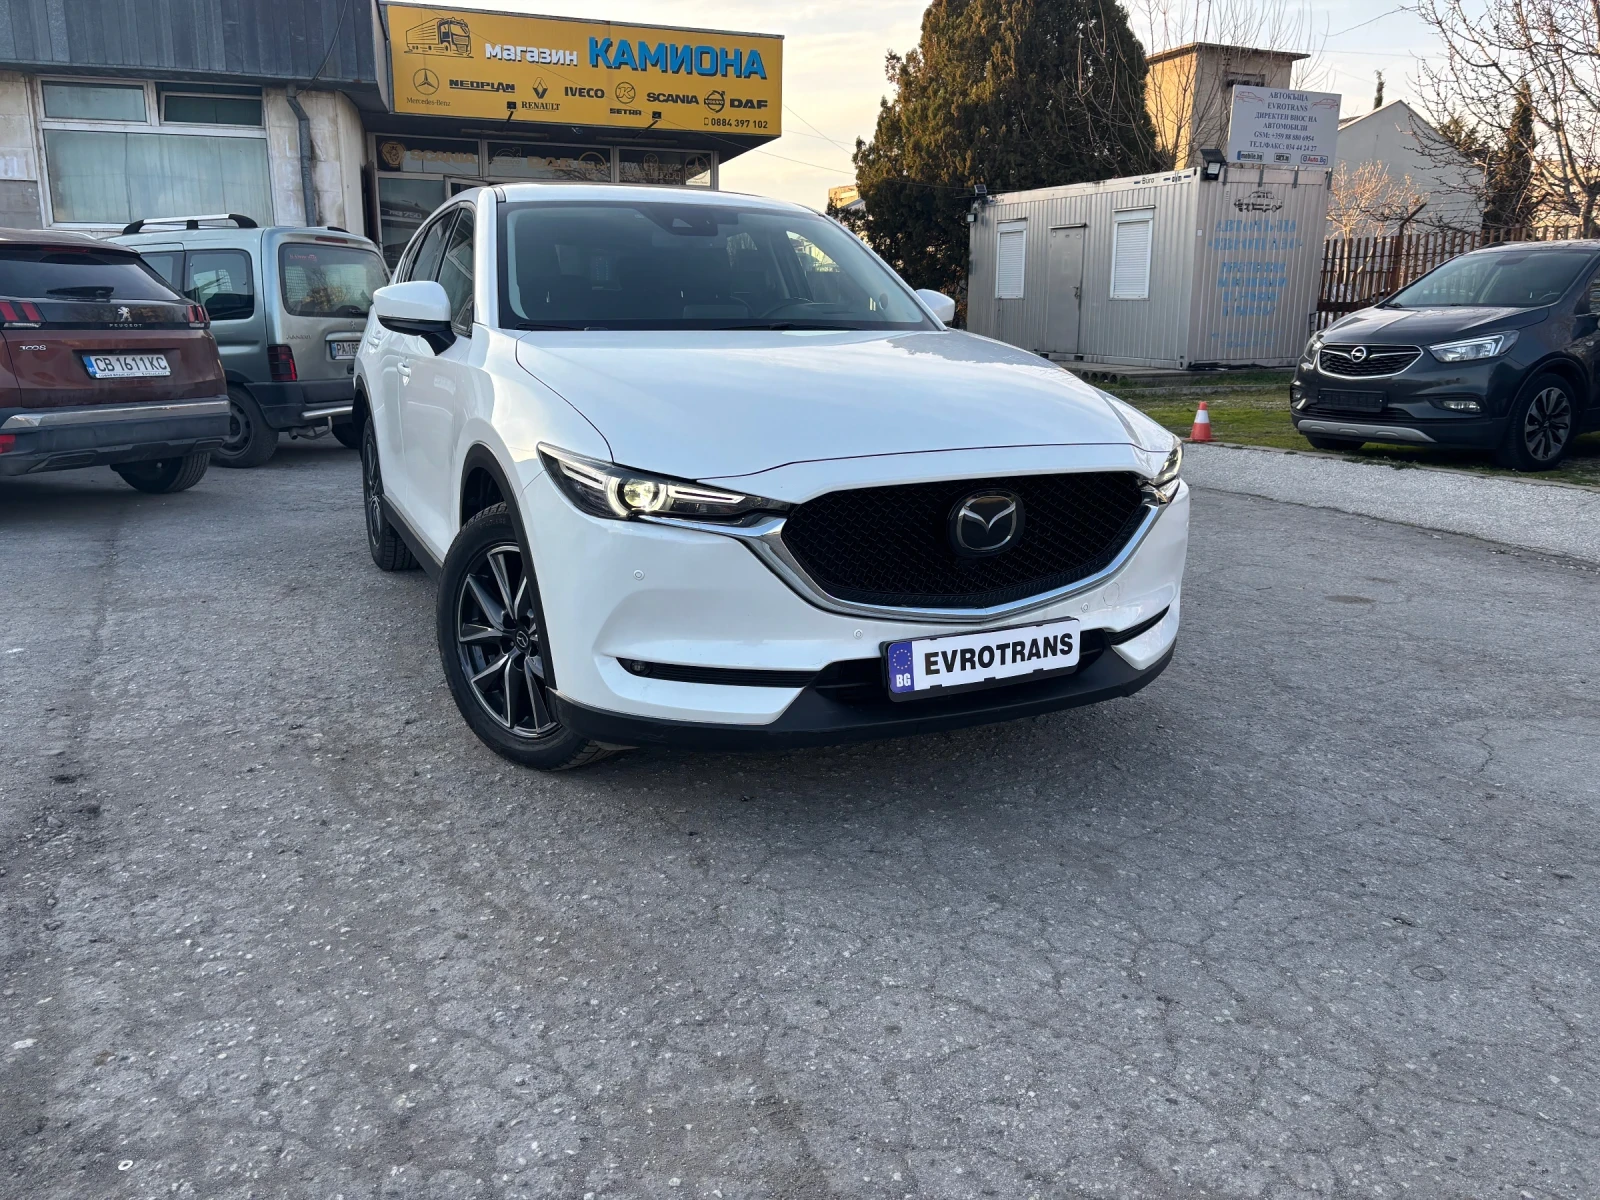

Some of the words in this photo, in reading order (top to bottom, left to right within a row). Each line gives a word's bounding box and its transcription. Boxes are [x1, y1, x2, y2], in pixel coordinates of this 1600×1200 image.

[485, 43, 578, 66] магазин
[588, 36, 767, 79] КАМИОНА
[449, 79, 515, 93] NEOPLAN
[564, 86, 605, 99] IVECO
[1269, 91, 1308, 101] АВТОКЪЩА
[406, 97, 451, 107] Mercedes-Benz
[646, 92, 699, 105] SCANIA
[521, 101, 560, 111] RENAULT
[730, 98, 768, 110] DAF
[1267, 102, 1308, 112] EVROTRANS
[609, 108, 642, 116] SETRA
[1254, 112, 1288, 121] ДИРЕКТЕН
[1289, 114, 1307, 122] ВНОС
[711, 118, 733, 127] 0884
[734, 119, 750, 128] 397
[753, 120, 768, 129] 102
[1263, 122, 1308, 131] АВТОМОБИЛИ
[1249, 141, 1285, 149] ТЕЛ/ФАКС:
[410, 149, 477, 164] SCANIA
[1241, 152, 1263, 160] mobile.bg
[1141, 177, 1155, 185] Büro
[924, 633, 1074, 676] EVROTRANS
[896, 673, 911, 688] BG
